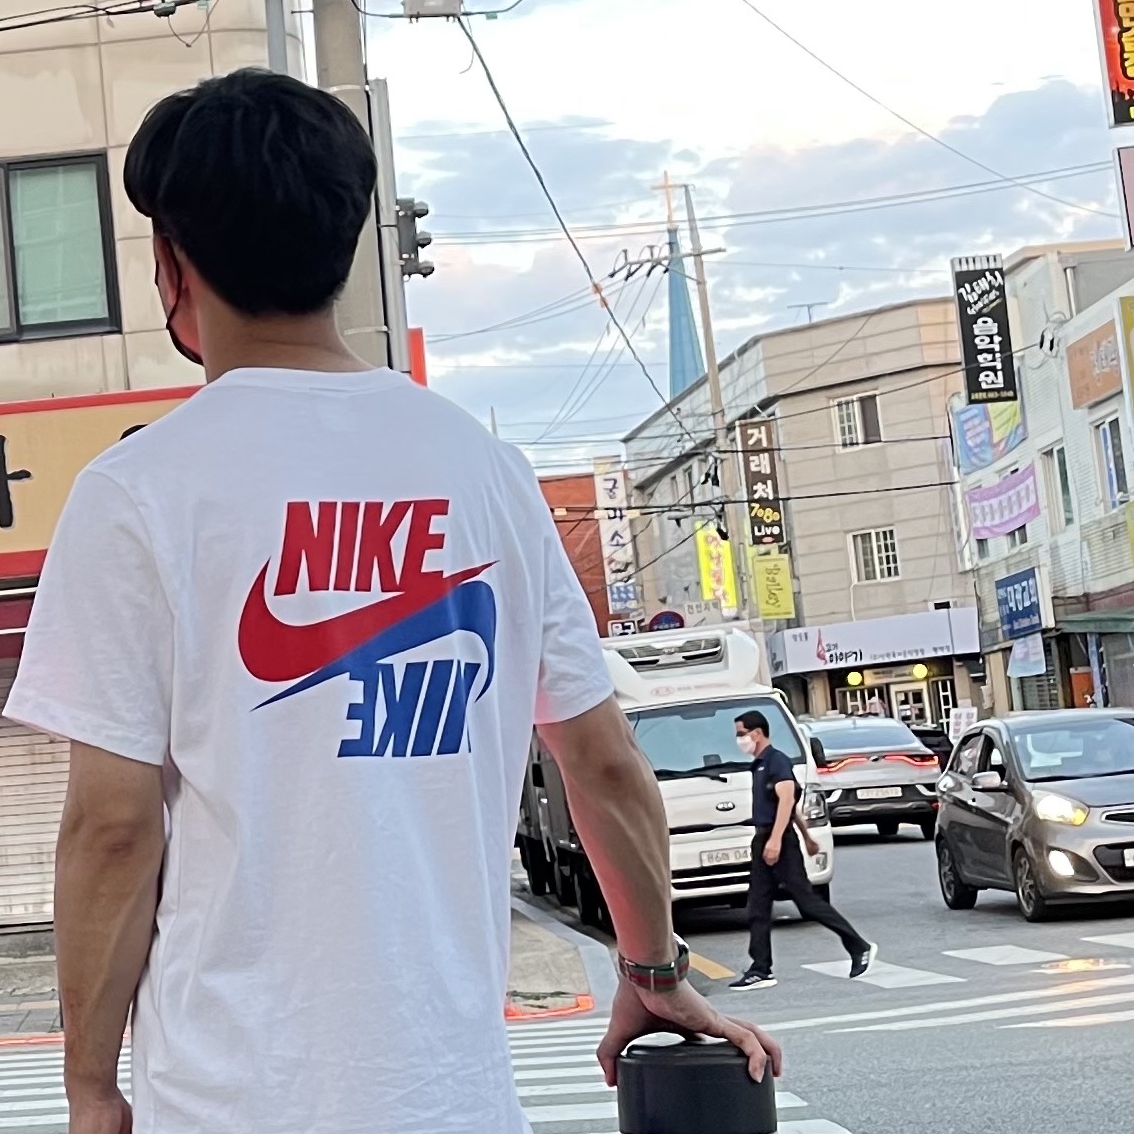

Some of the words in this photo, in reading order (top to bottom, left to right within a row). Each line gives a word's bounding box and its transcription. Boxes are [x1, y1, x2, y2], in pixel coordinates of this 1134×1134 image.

[973, 316, 1005, 389] 음악학원
[747, 426, 774, 500] 거래처
[750, 503, 780, 523] 7080
[754, 524, 780, 536] Live
[273, 499, 449, 596] NIKE
[829, 648, 863, 664] 이야기
